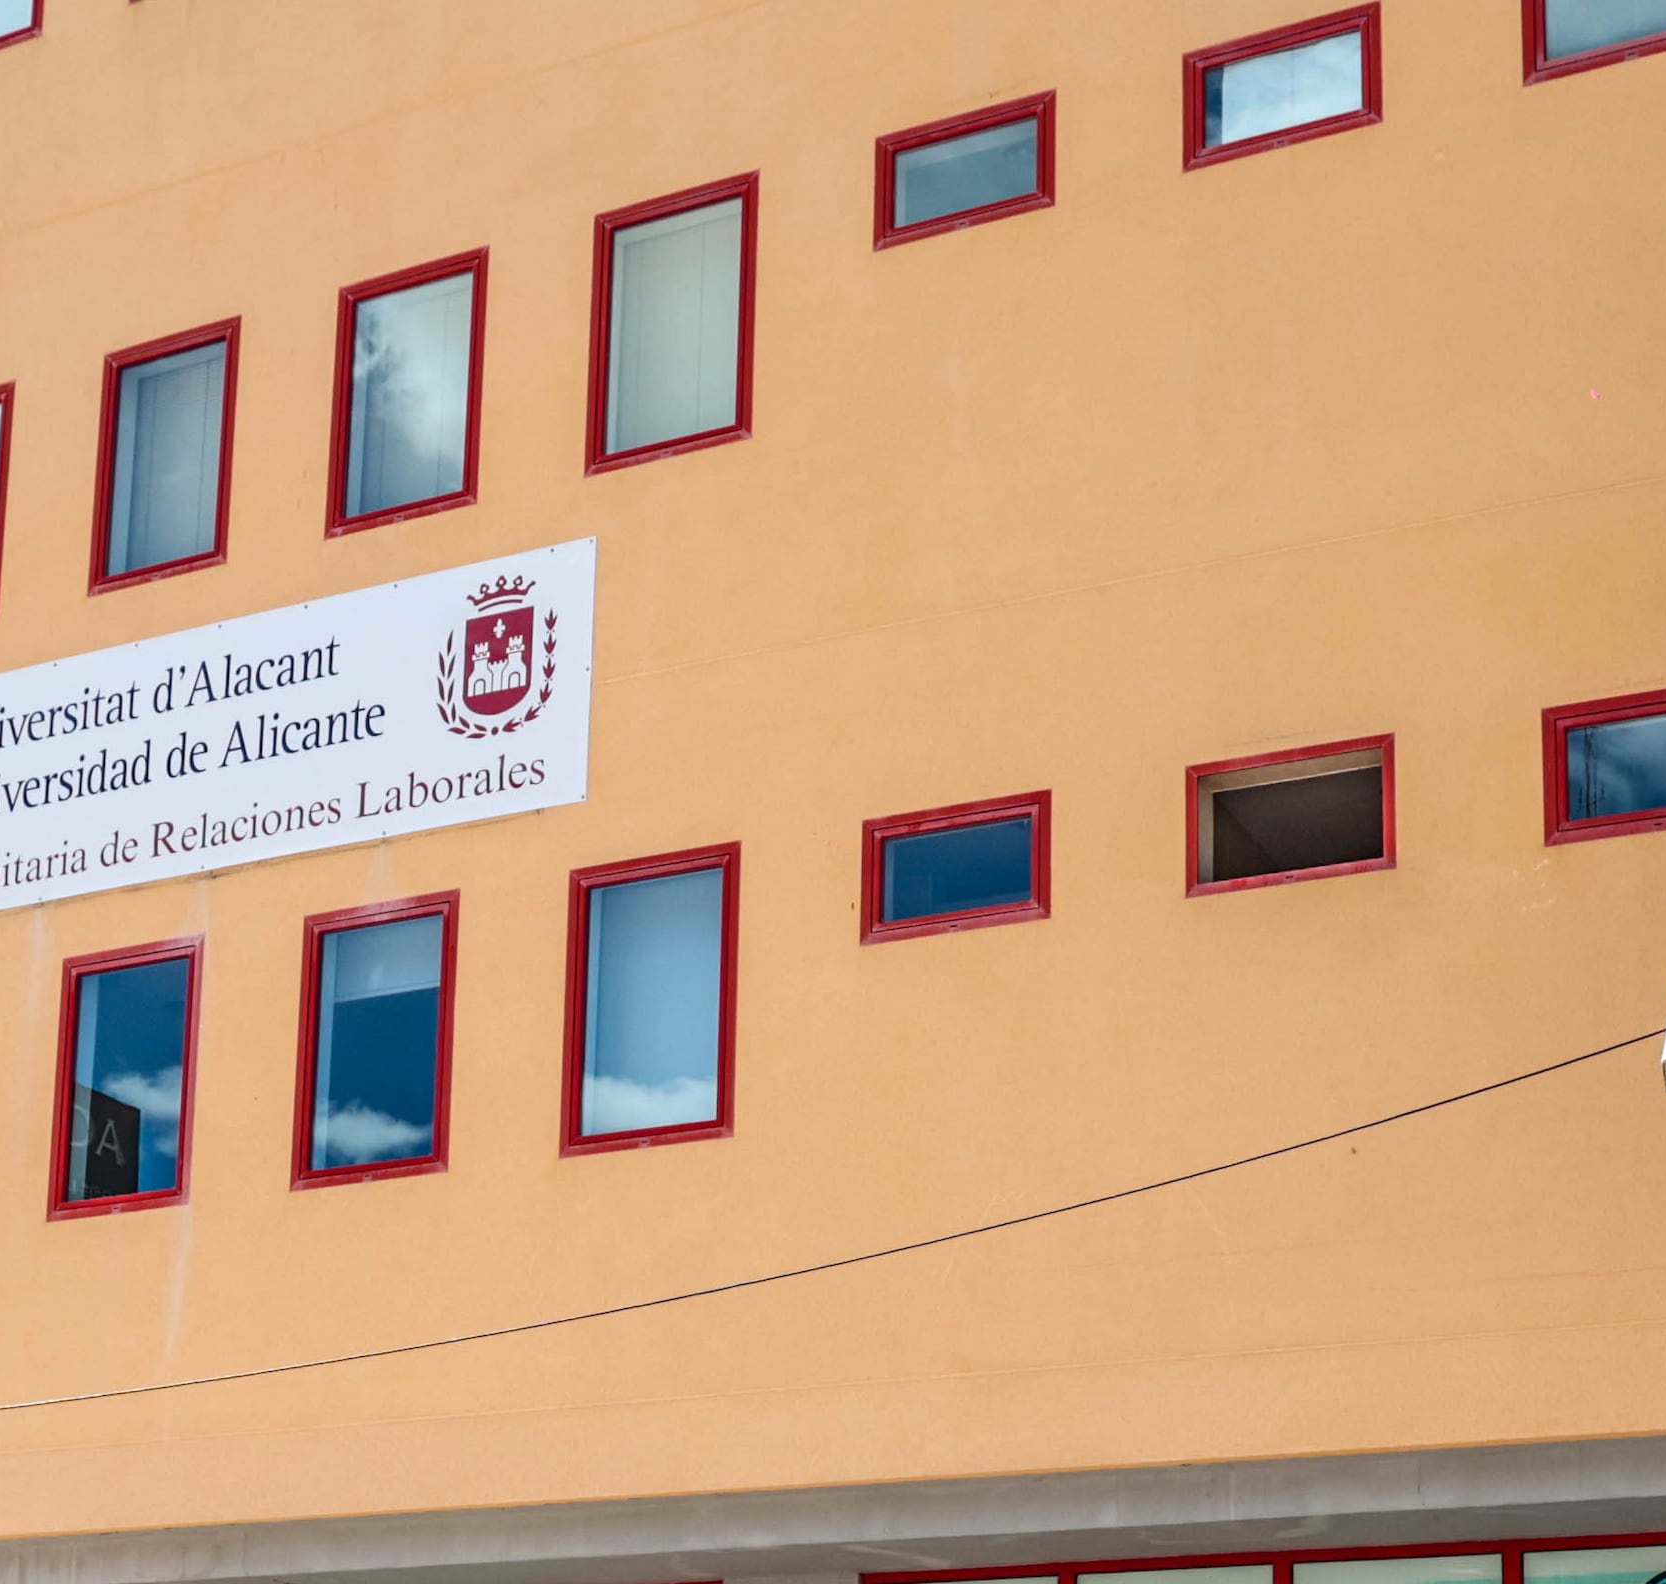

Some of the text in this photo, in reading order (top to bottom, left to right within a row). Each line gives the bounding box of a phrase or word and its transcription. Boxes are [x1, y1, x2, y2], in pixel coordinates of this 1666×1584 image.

[152, 635, 342, 714] d'Alacant
[165, 732, 209, 779] de
[218, 699, 386, 769] Alicante
[99, 830, 139, 868] de
[150, 796, 342, 858] Relaciones
[354, 754, 547, 820] Laborales
